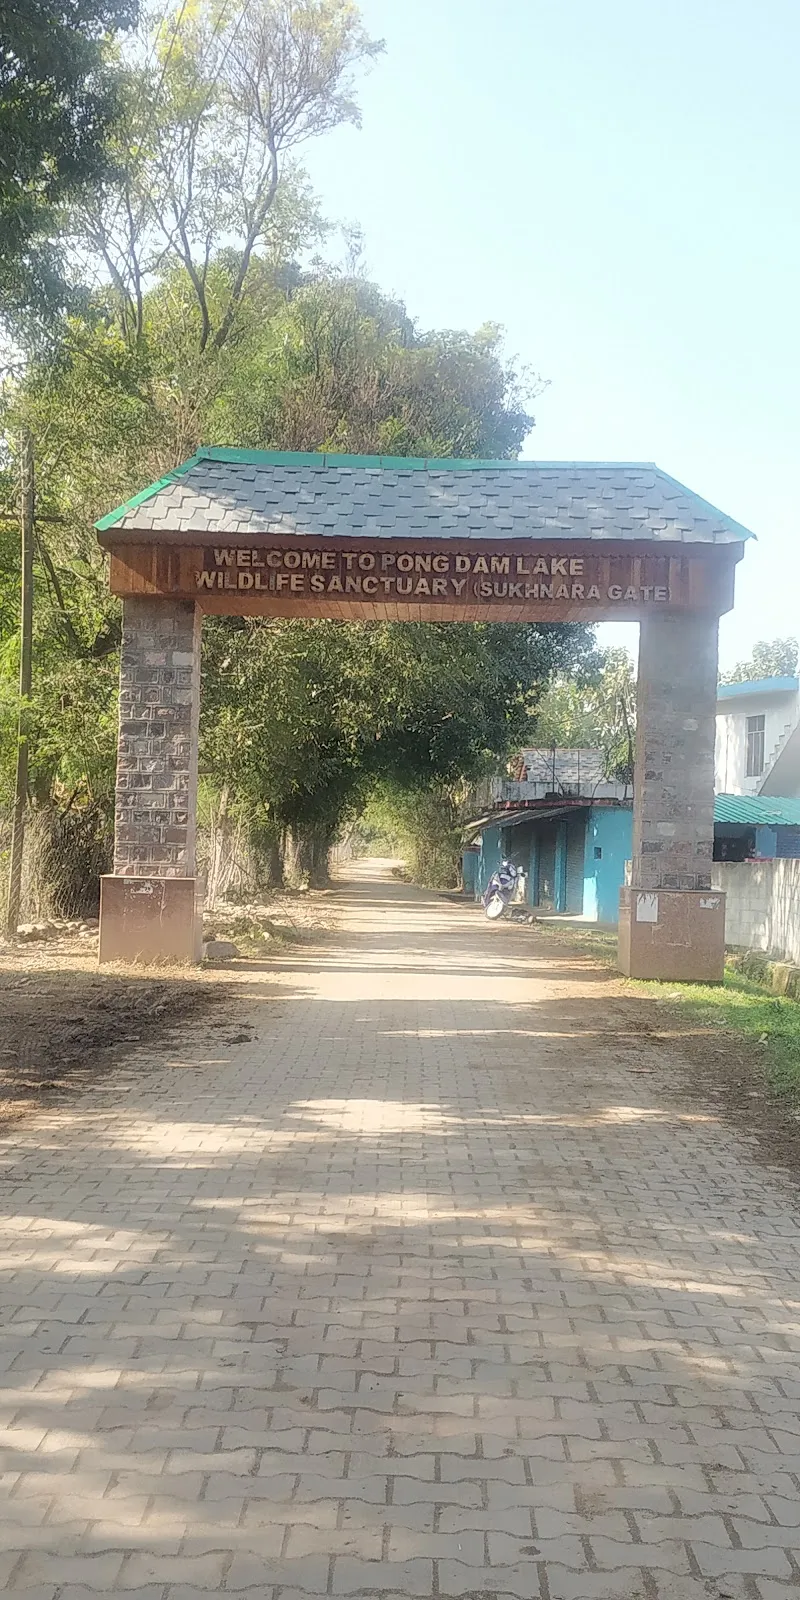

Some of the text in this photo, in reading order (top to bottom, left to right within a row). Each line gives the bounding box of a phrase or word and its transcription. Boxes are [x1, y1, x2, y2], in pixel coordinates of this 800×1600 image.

[213, 549, 584, 576] WELCOME TO PONG DAM LAKE
[195, 571, 305, 592] WILDLIFE
[310, 574, 467, 596] SANCTUARY
[473, 581, 601, 600] (SUKHNARA
